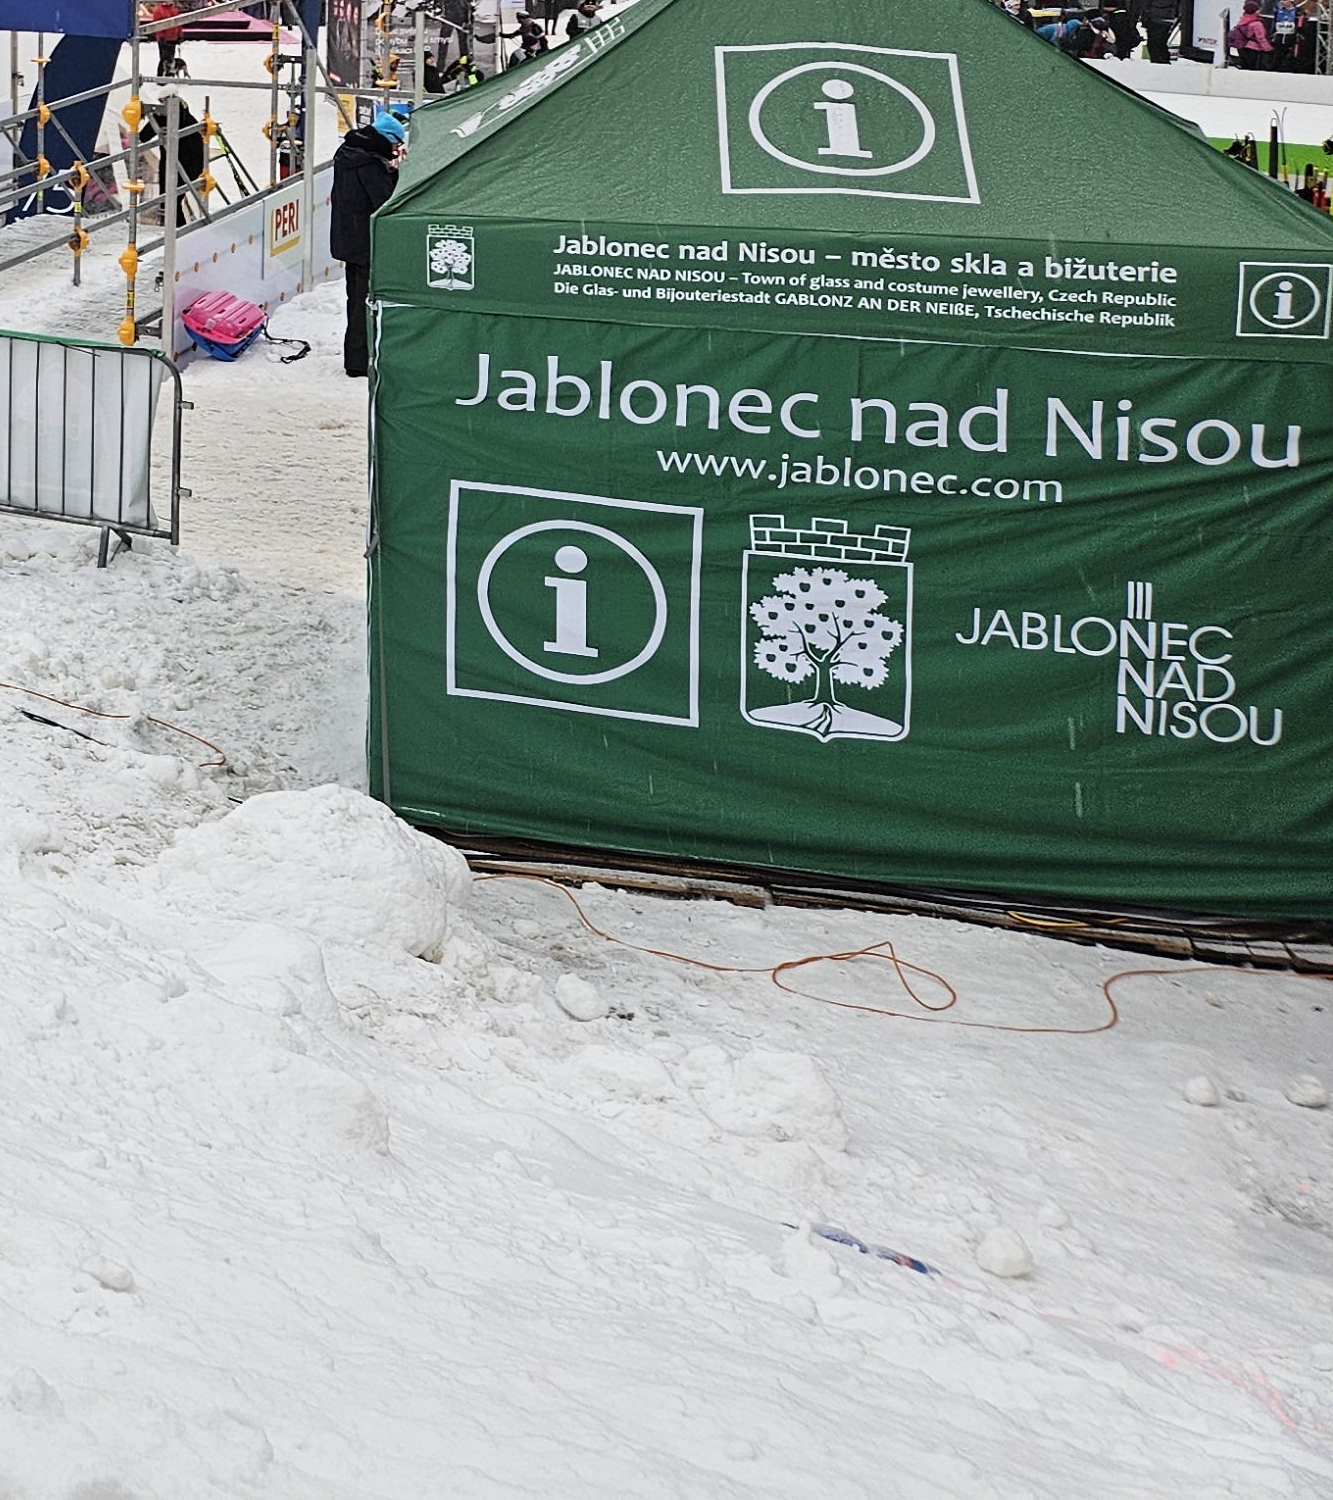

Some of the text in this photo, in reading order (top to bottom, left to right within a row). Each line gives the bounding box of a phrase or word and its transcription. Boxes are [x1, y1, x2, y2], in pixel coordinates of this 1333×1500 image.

[274, 198, 300, 242] PERI
[553, 234, 670, 259] Jablonec
[679, 240, 728, 261] nad
[738, 242, 816, 265] Nisou
[851, 246, 941, 272] město
[950, 252, 1007, 276] skla
[1017, 260, 1034, 277] a
[1045, 256, 1178, 284] bižuterie
[553, 263, 634, 279] JABLONEC
[636, 267, 671, 281] NAD
[675, 269, 725, 283] NISOU
[742, 272, 785, 286] Town
[788, 273, 807, 287] of
[809, 274, 850, 290] glass
[853, 278, 884, 291] and
[887, 280, 959, 297] costume
[962, 283, 1045, 303] jewellery,
[1048, 288, 1097, 304] Czech
[1101, 291, 1177, 308] Republic
[553, 281, 579, 295] Die
[582, 283, 619, 297] Glas-
[622, 285, 652, 298] und
[656, 286, 770, 304] Bijouteriestadt
[774, 292, 853, 308] GABLONZ
[857, 296, 882, 310] AN
[887, 299, 921, 314] DER
[983, 305, 1095, 323] Tschechische
[1099, 311, 1176, 328] Republik
[455, 353, 1302, 469] Jablonec nad Nisou
[656, 449, 1063, 503] www.jablonec.com
[955, 607, 1233, 665] JABLONEC
[1116, 658, 1236, 703] NAD
[1116, 694, 1283, 747] NISOU
